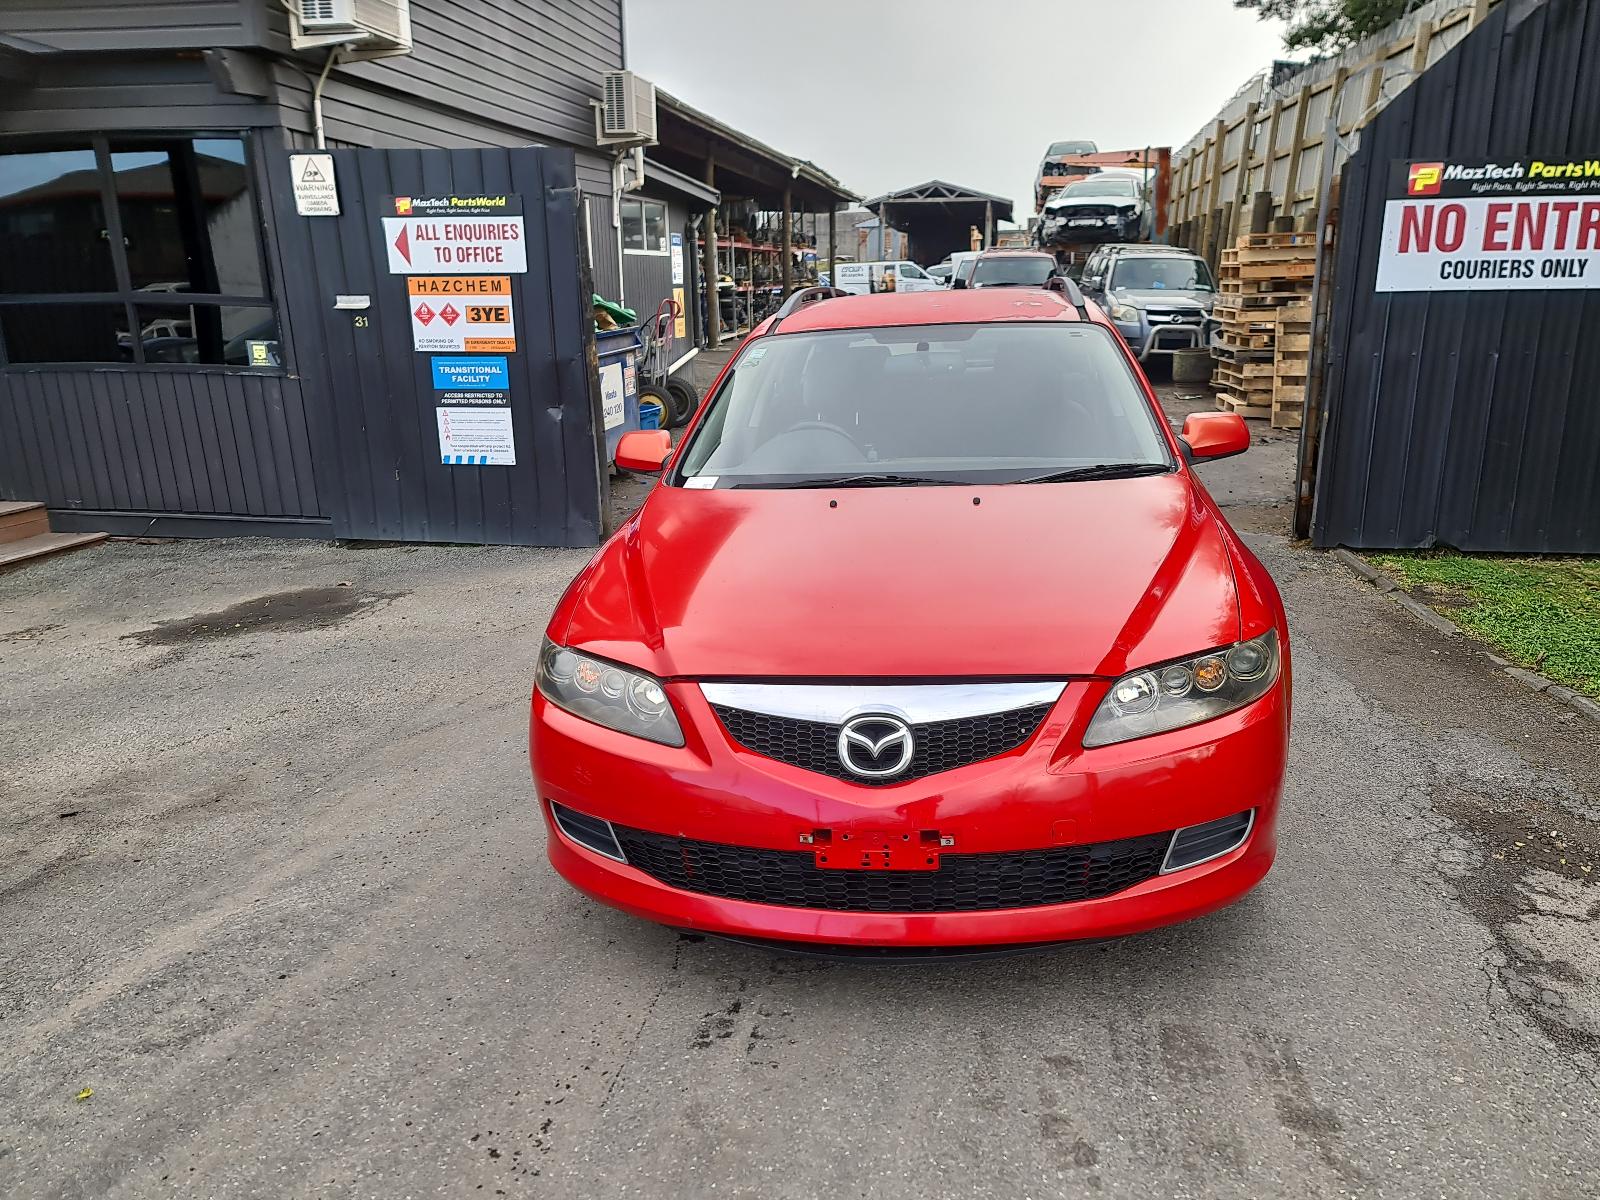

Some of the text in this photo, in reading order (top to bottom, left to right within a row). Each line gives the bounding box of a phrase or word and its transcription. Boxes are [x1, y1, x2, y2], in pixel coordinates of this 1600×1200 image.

[1443, 161, 1524, 180] MazTech
[1471, 182, 1492, 193] Right
[1515, 181, 1536, 192] Right
[1568, 180, 1589, 191] Right
[412, 196, 506, 207] MazTech PartsWorld
[416, 223, 519, 242] ALL ENQUIRIES
[1398, 204, 1467, 253] NO
[434, 247, 504, 263] TO OFFICE
[1440, 258, 1589, 280] COURIERS ONLY
[417, 280, 502, 292] HAZCHEM
[354, 315, 369, 327] 31
[470, 307, 505, 322] 3YE
[439, 366, 502, 374] TRANSITIONAL
